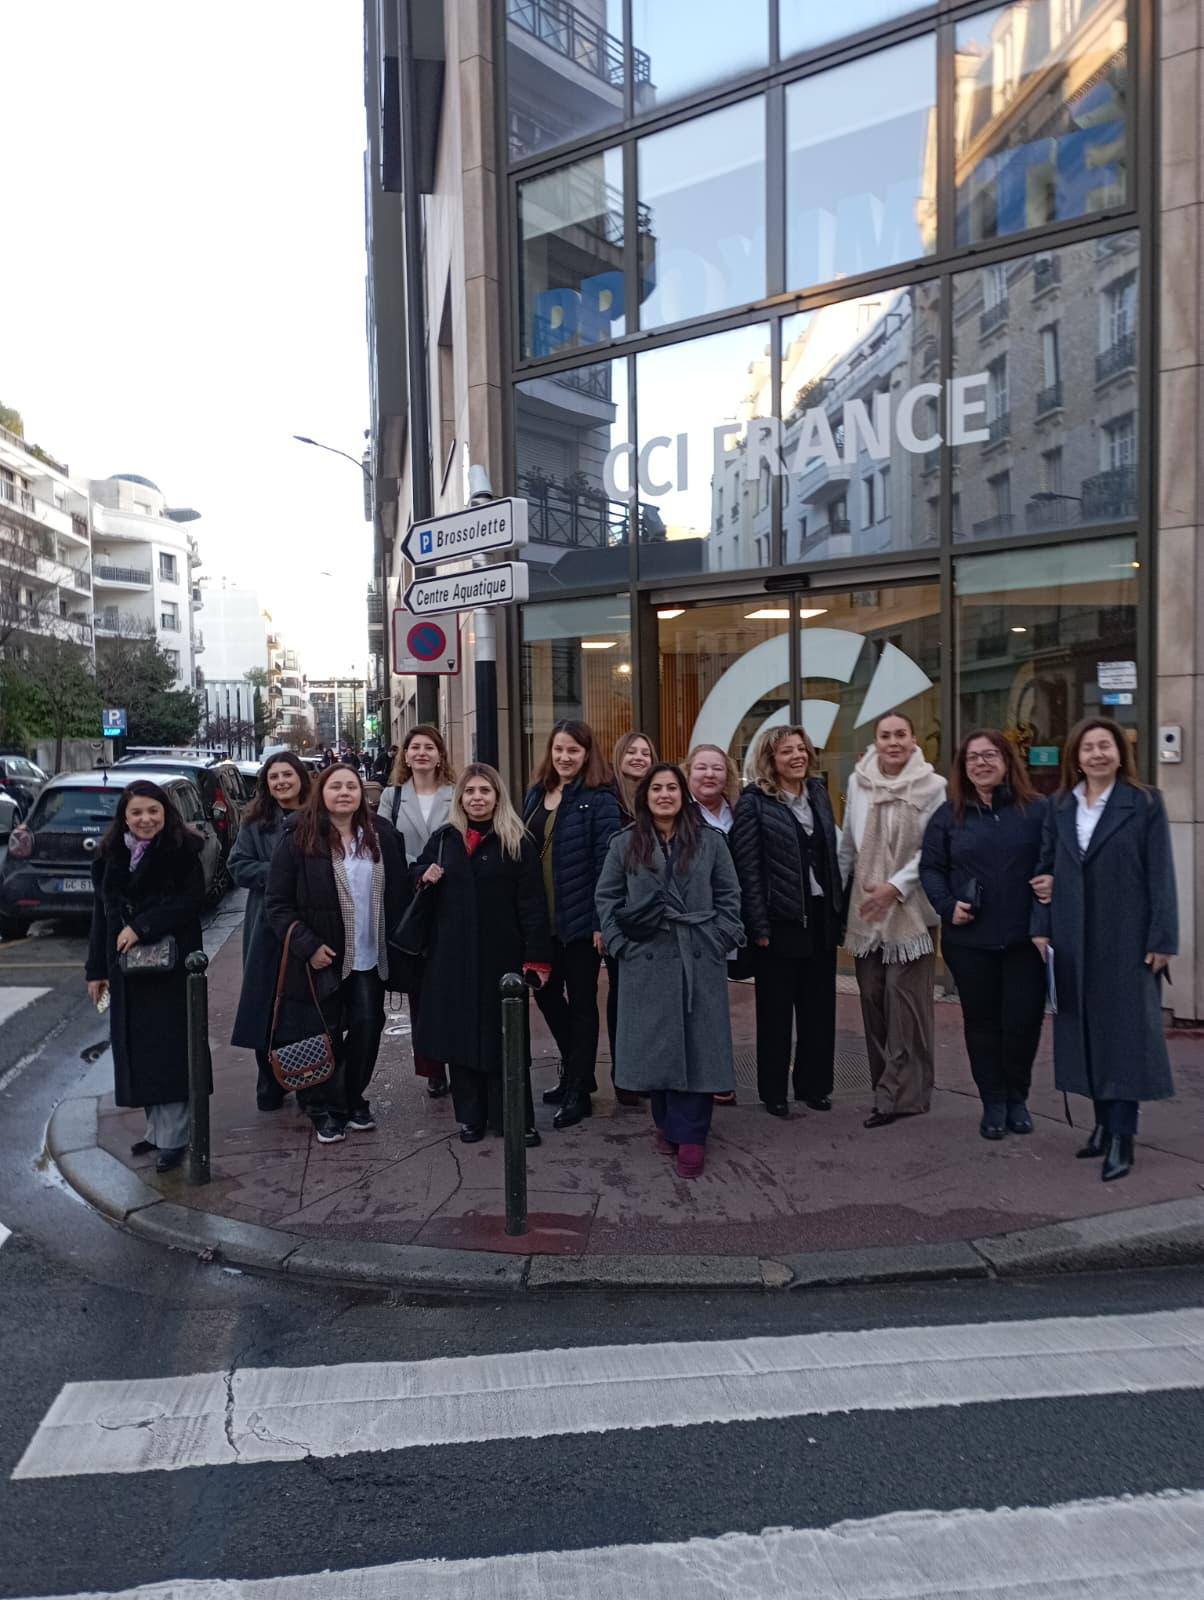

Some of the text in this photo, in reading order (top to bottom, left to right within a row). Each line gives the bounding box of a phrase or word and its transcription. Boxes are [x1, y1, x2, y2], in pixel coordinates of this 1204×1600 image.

[603, 372, 990, 501] CCI FRANCE
[422, 518, 506, 551] P Brossolette
[416, 578, 507, 606] Centre Aquatique
